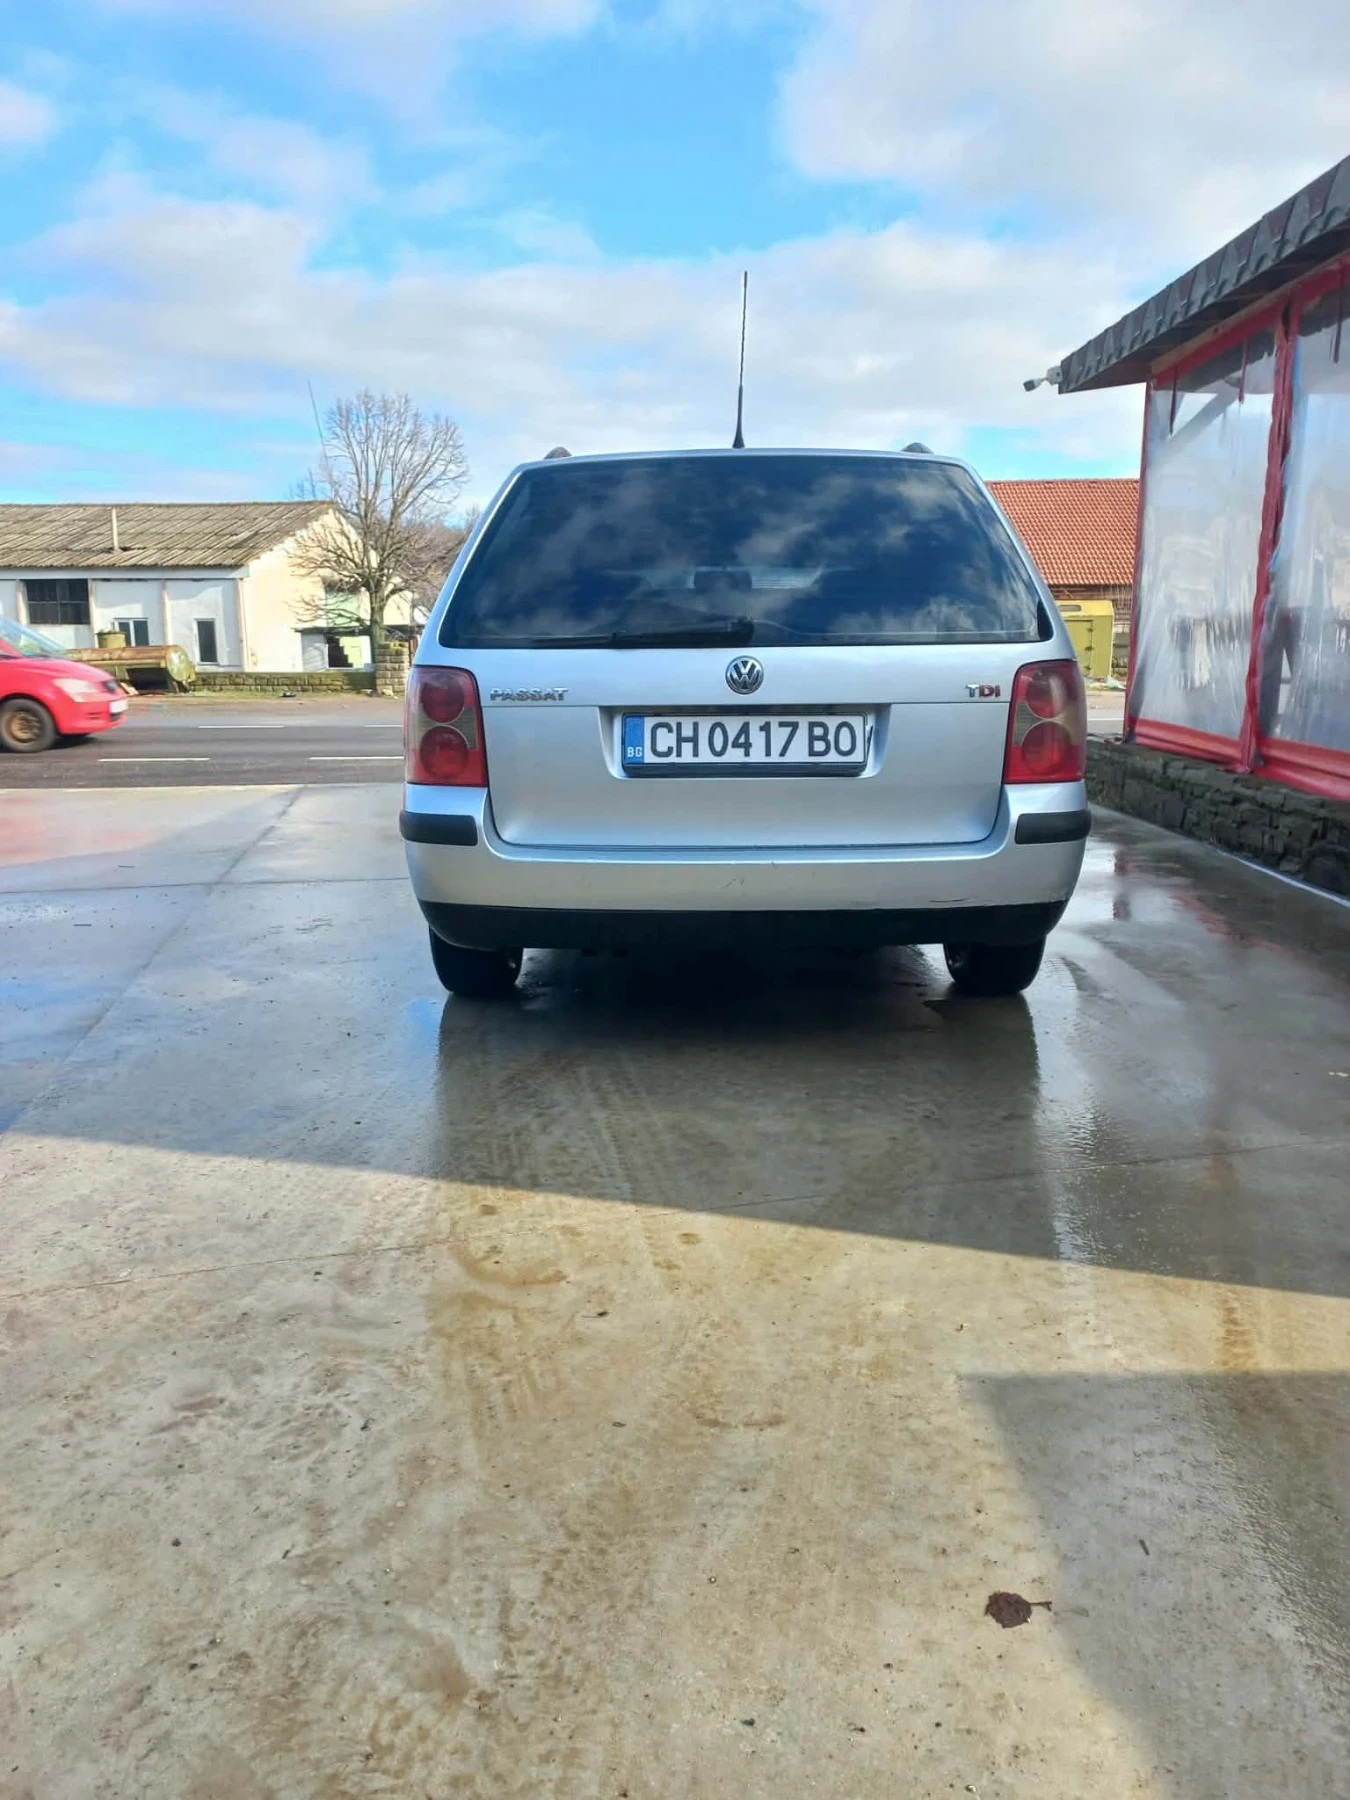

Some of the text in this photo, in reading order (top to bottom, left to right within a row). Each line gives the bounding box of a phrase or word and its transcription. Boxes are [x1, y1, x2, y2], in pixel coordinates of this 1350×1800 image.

[489, 687, 569, 701] PASSAT
[965, 684, 1001, 698] TDI
[627, 746, 643, 758] BG
